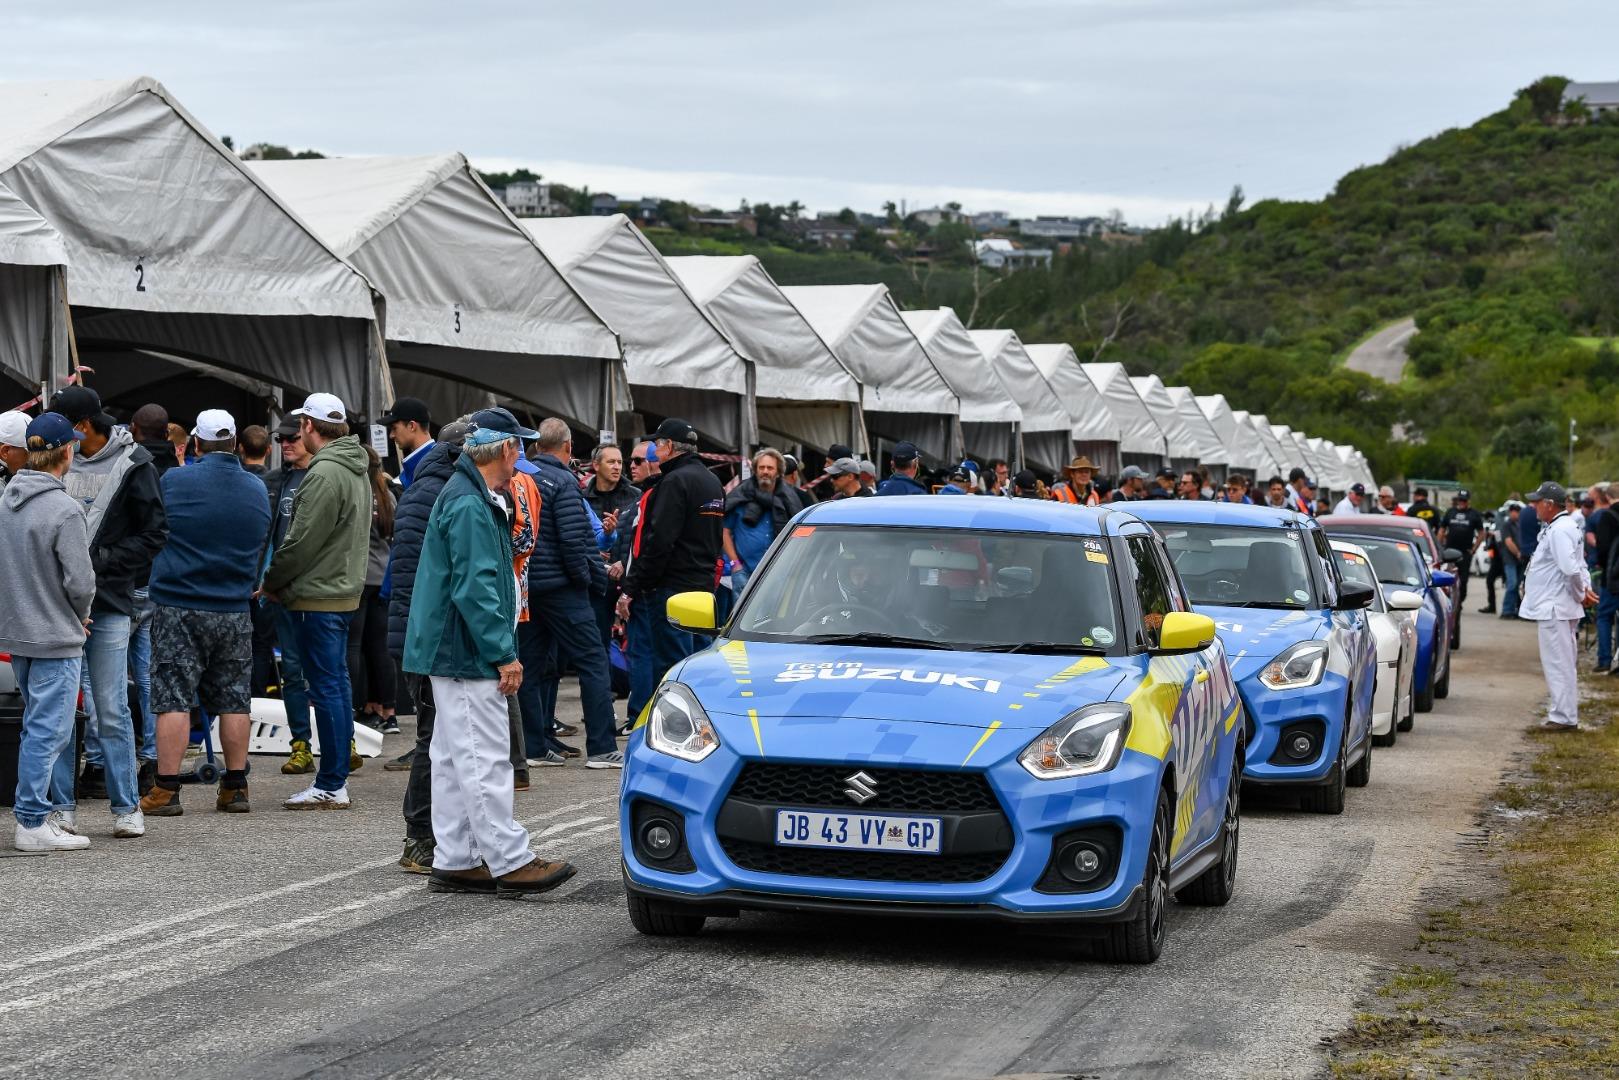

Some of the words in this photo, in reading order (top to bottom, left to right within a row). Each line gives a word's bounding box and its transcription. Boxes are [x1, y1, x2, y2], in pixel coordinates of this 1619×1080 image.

[135, 264, 145, 292] 2
[454, 311, 461, 334] 3
[783, 661, 863, 671] Team
[773, 667, 1002, 694] SUZUKI
[783, 814, 810, 840] JB
[821, 817, 848, 844] 43
[860, 819, 887, 845] VY
[907, 821, 935, 848] GP
